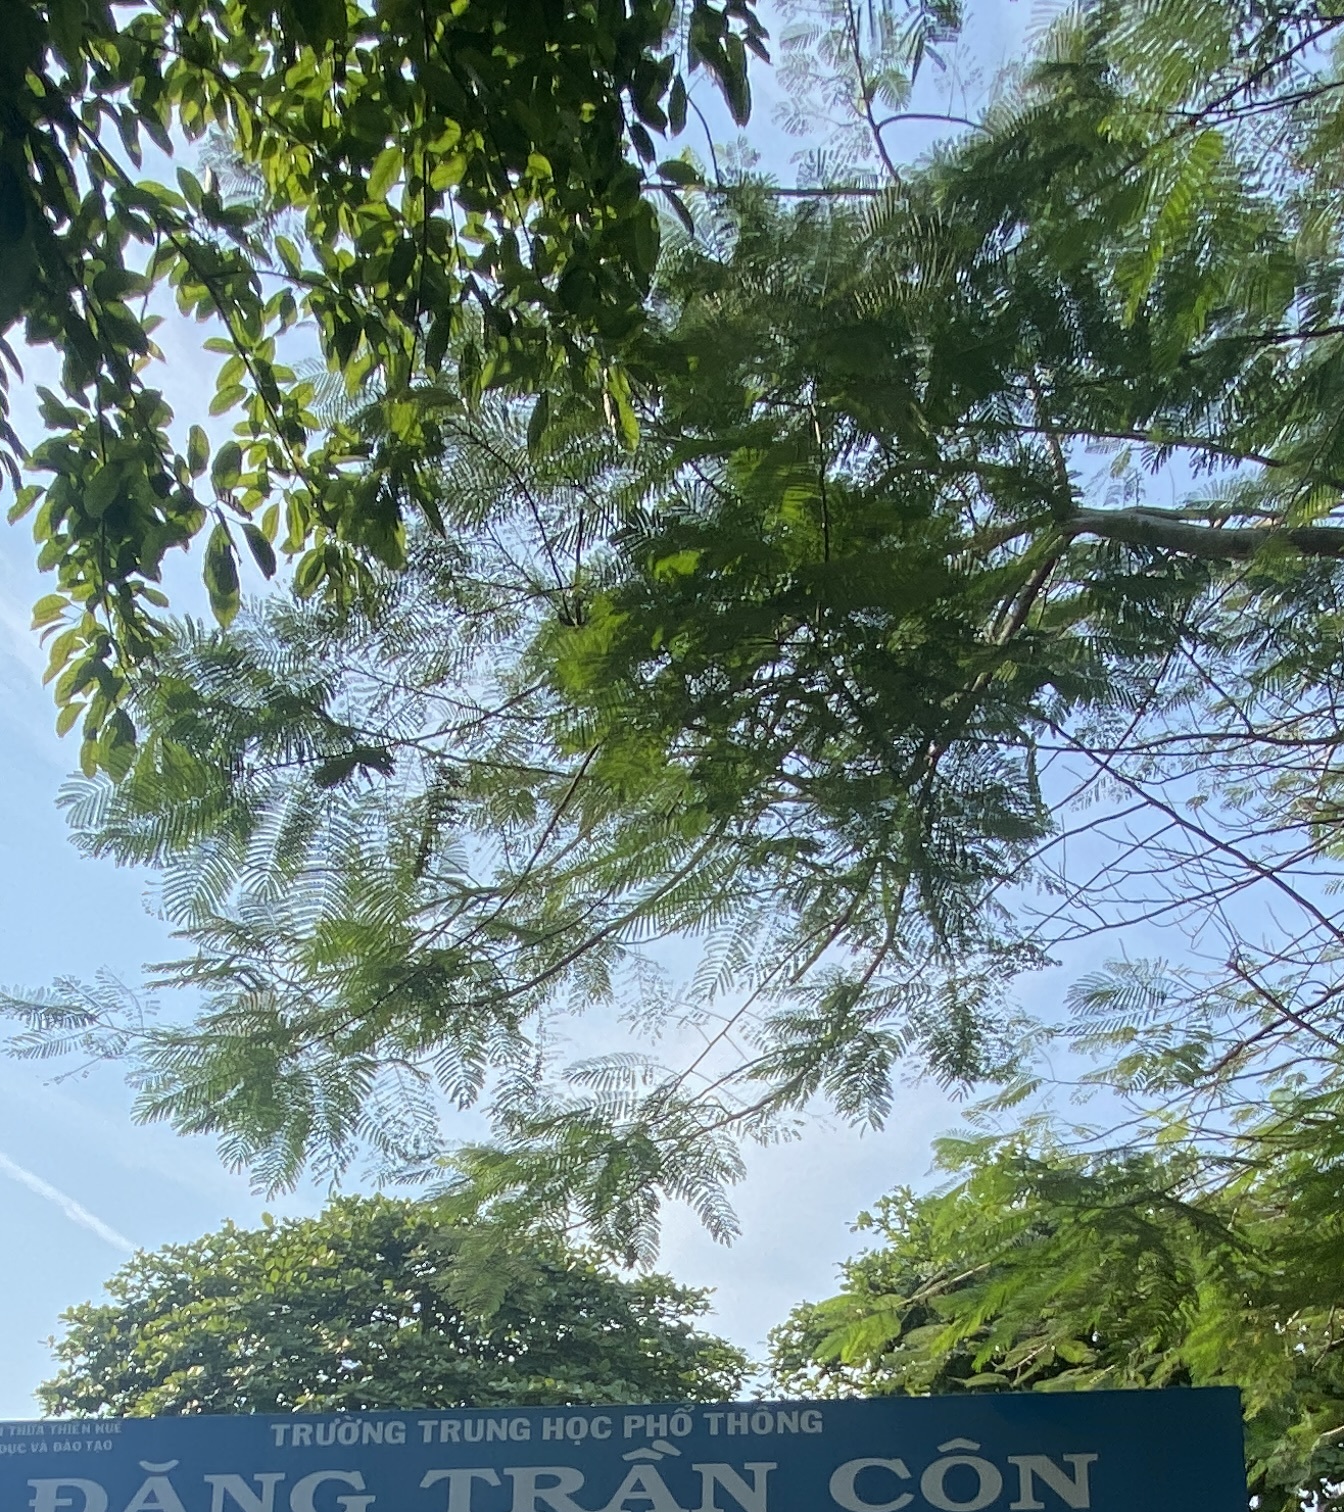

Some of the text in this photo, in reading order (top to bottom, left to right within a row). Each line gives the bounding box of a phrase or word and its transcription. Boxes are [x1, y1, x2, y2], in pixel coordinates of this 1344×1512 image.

[270, 1404, 824, 1447] TRƯỜNG TRUNG HỌC PHỔ THÔNG
[30, 1439, 48, 1453] VÀ
[86, 1439, 113, 1454] TẠO
